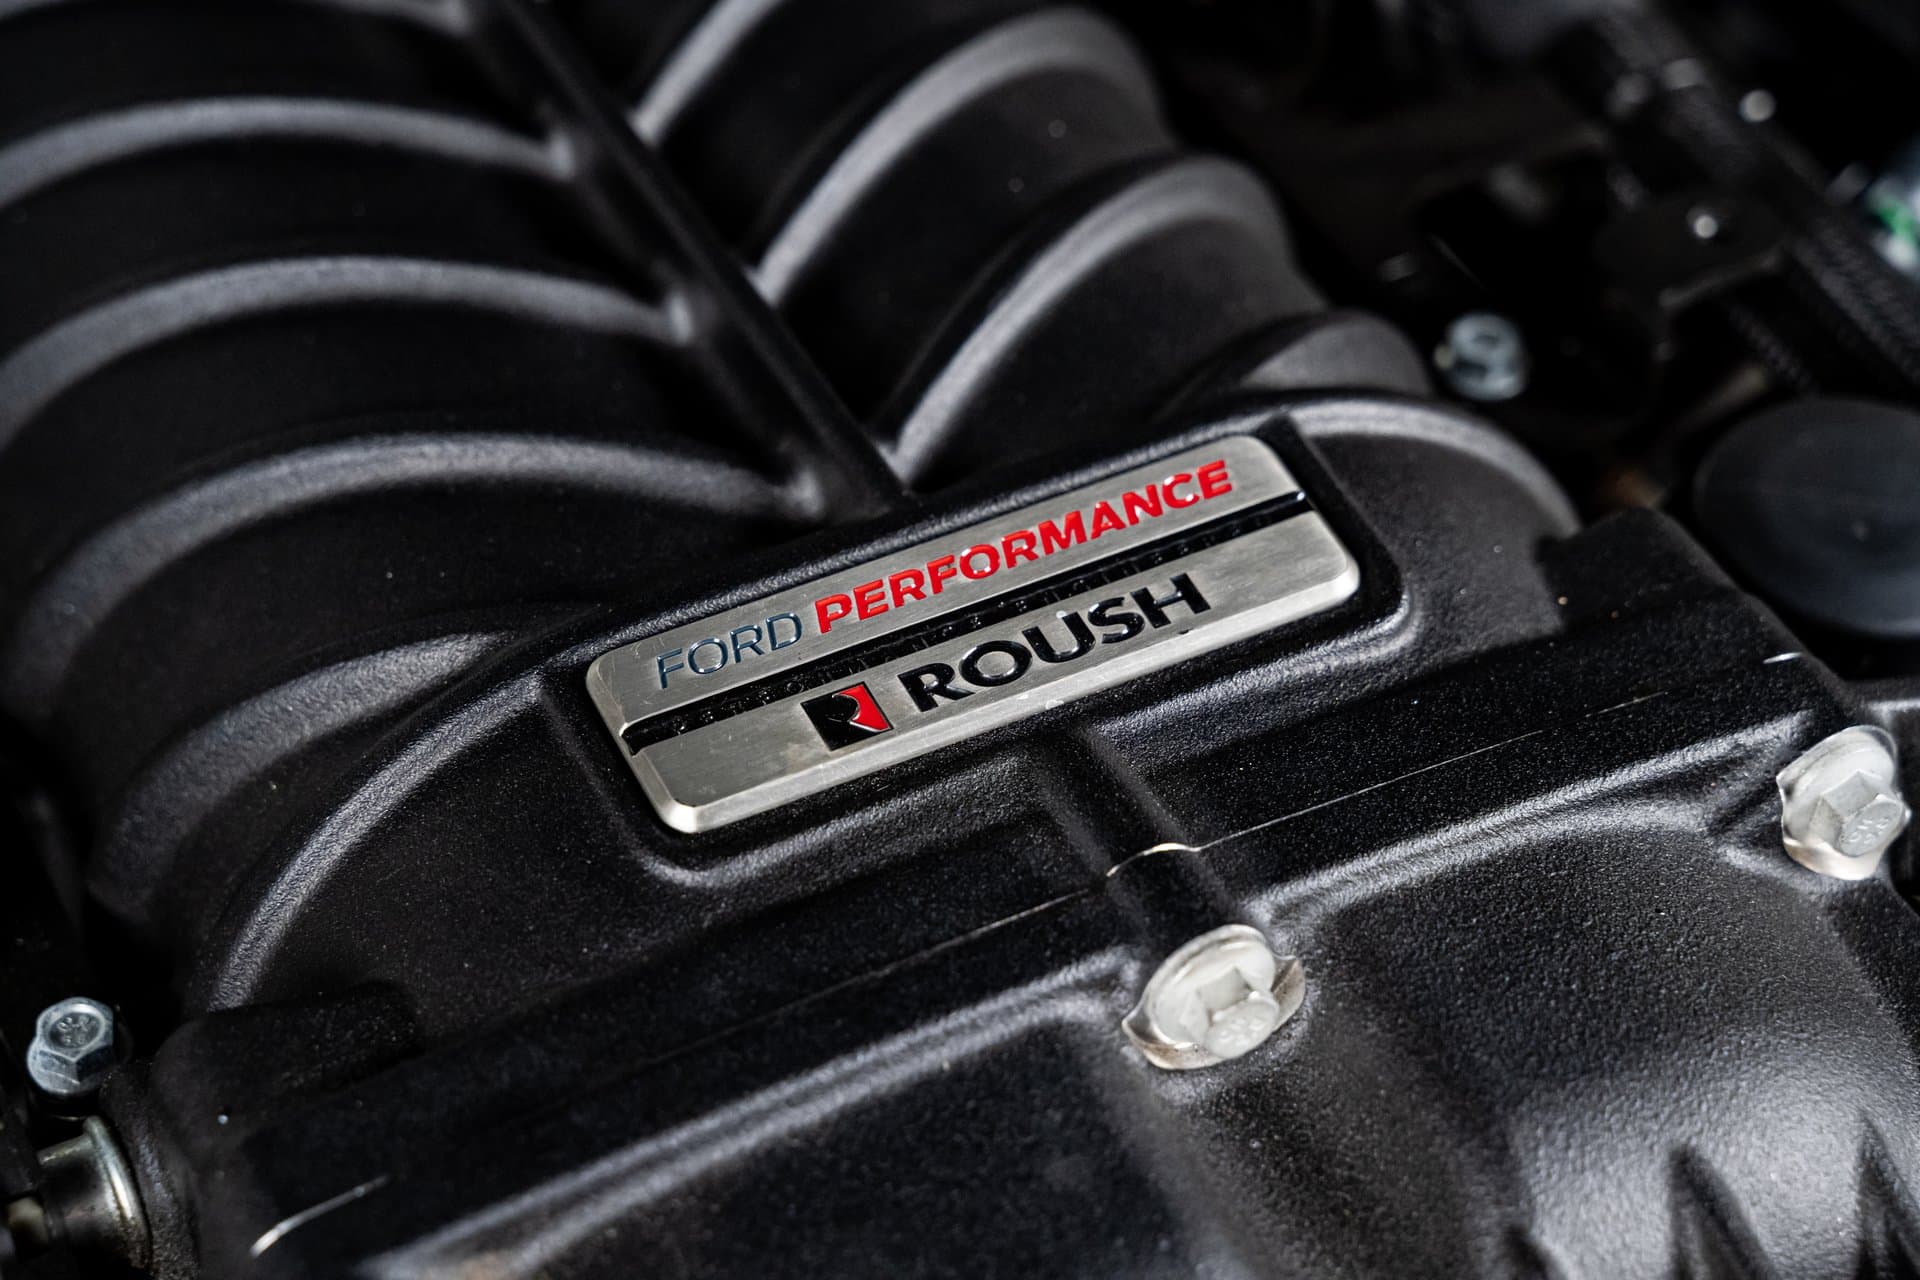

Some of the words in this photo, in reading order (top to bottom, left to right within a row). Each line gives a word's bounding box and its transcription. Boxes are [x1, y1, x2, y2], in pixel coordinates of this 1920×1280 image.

[657, 612, 803, 689] FORD
[815, 460, 1233, 634] PERFORMANCE
[897, 573, 1212, 712] ROUSH
